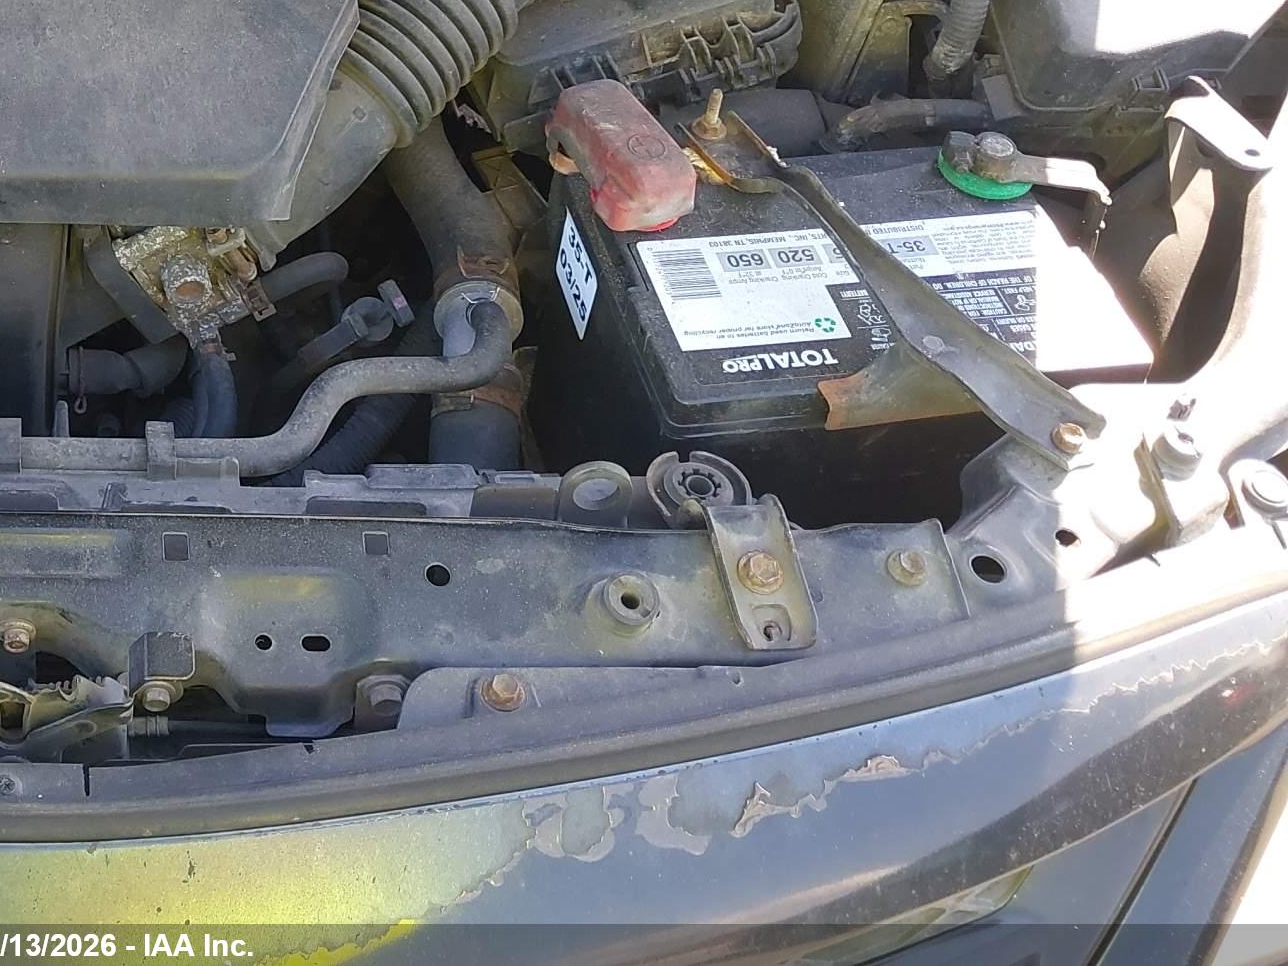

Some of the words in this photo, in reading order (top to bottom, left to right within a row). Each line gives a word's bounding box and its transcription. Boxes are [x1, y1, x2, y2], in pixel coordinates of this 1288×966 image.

[873, 225, 924, 234] DISTRIBUTED
[745, 236, 786, 245] MEMPHIS,
[887, 240, 925, 254] 35-T
[568, 225, 592, 285] 35-T
[727, 253, 763, 268] 650
[778, 249, 814, 263] 520
[559, 248, 587, 322] 03/25
[683, 328, 717, 337] recycling
[736, 330, 768, 338] batteries
[770, 329, 788, 337] used
[722, 348, 838, 373] TOTALPRO
